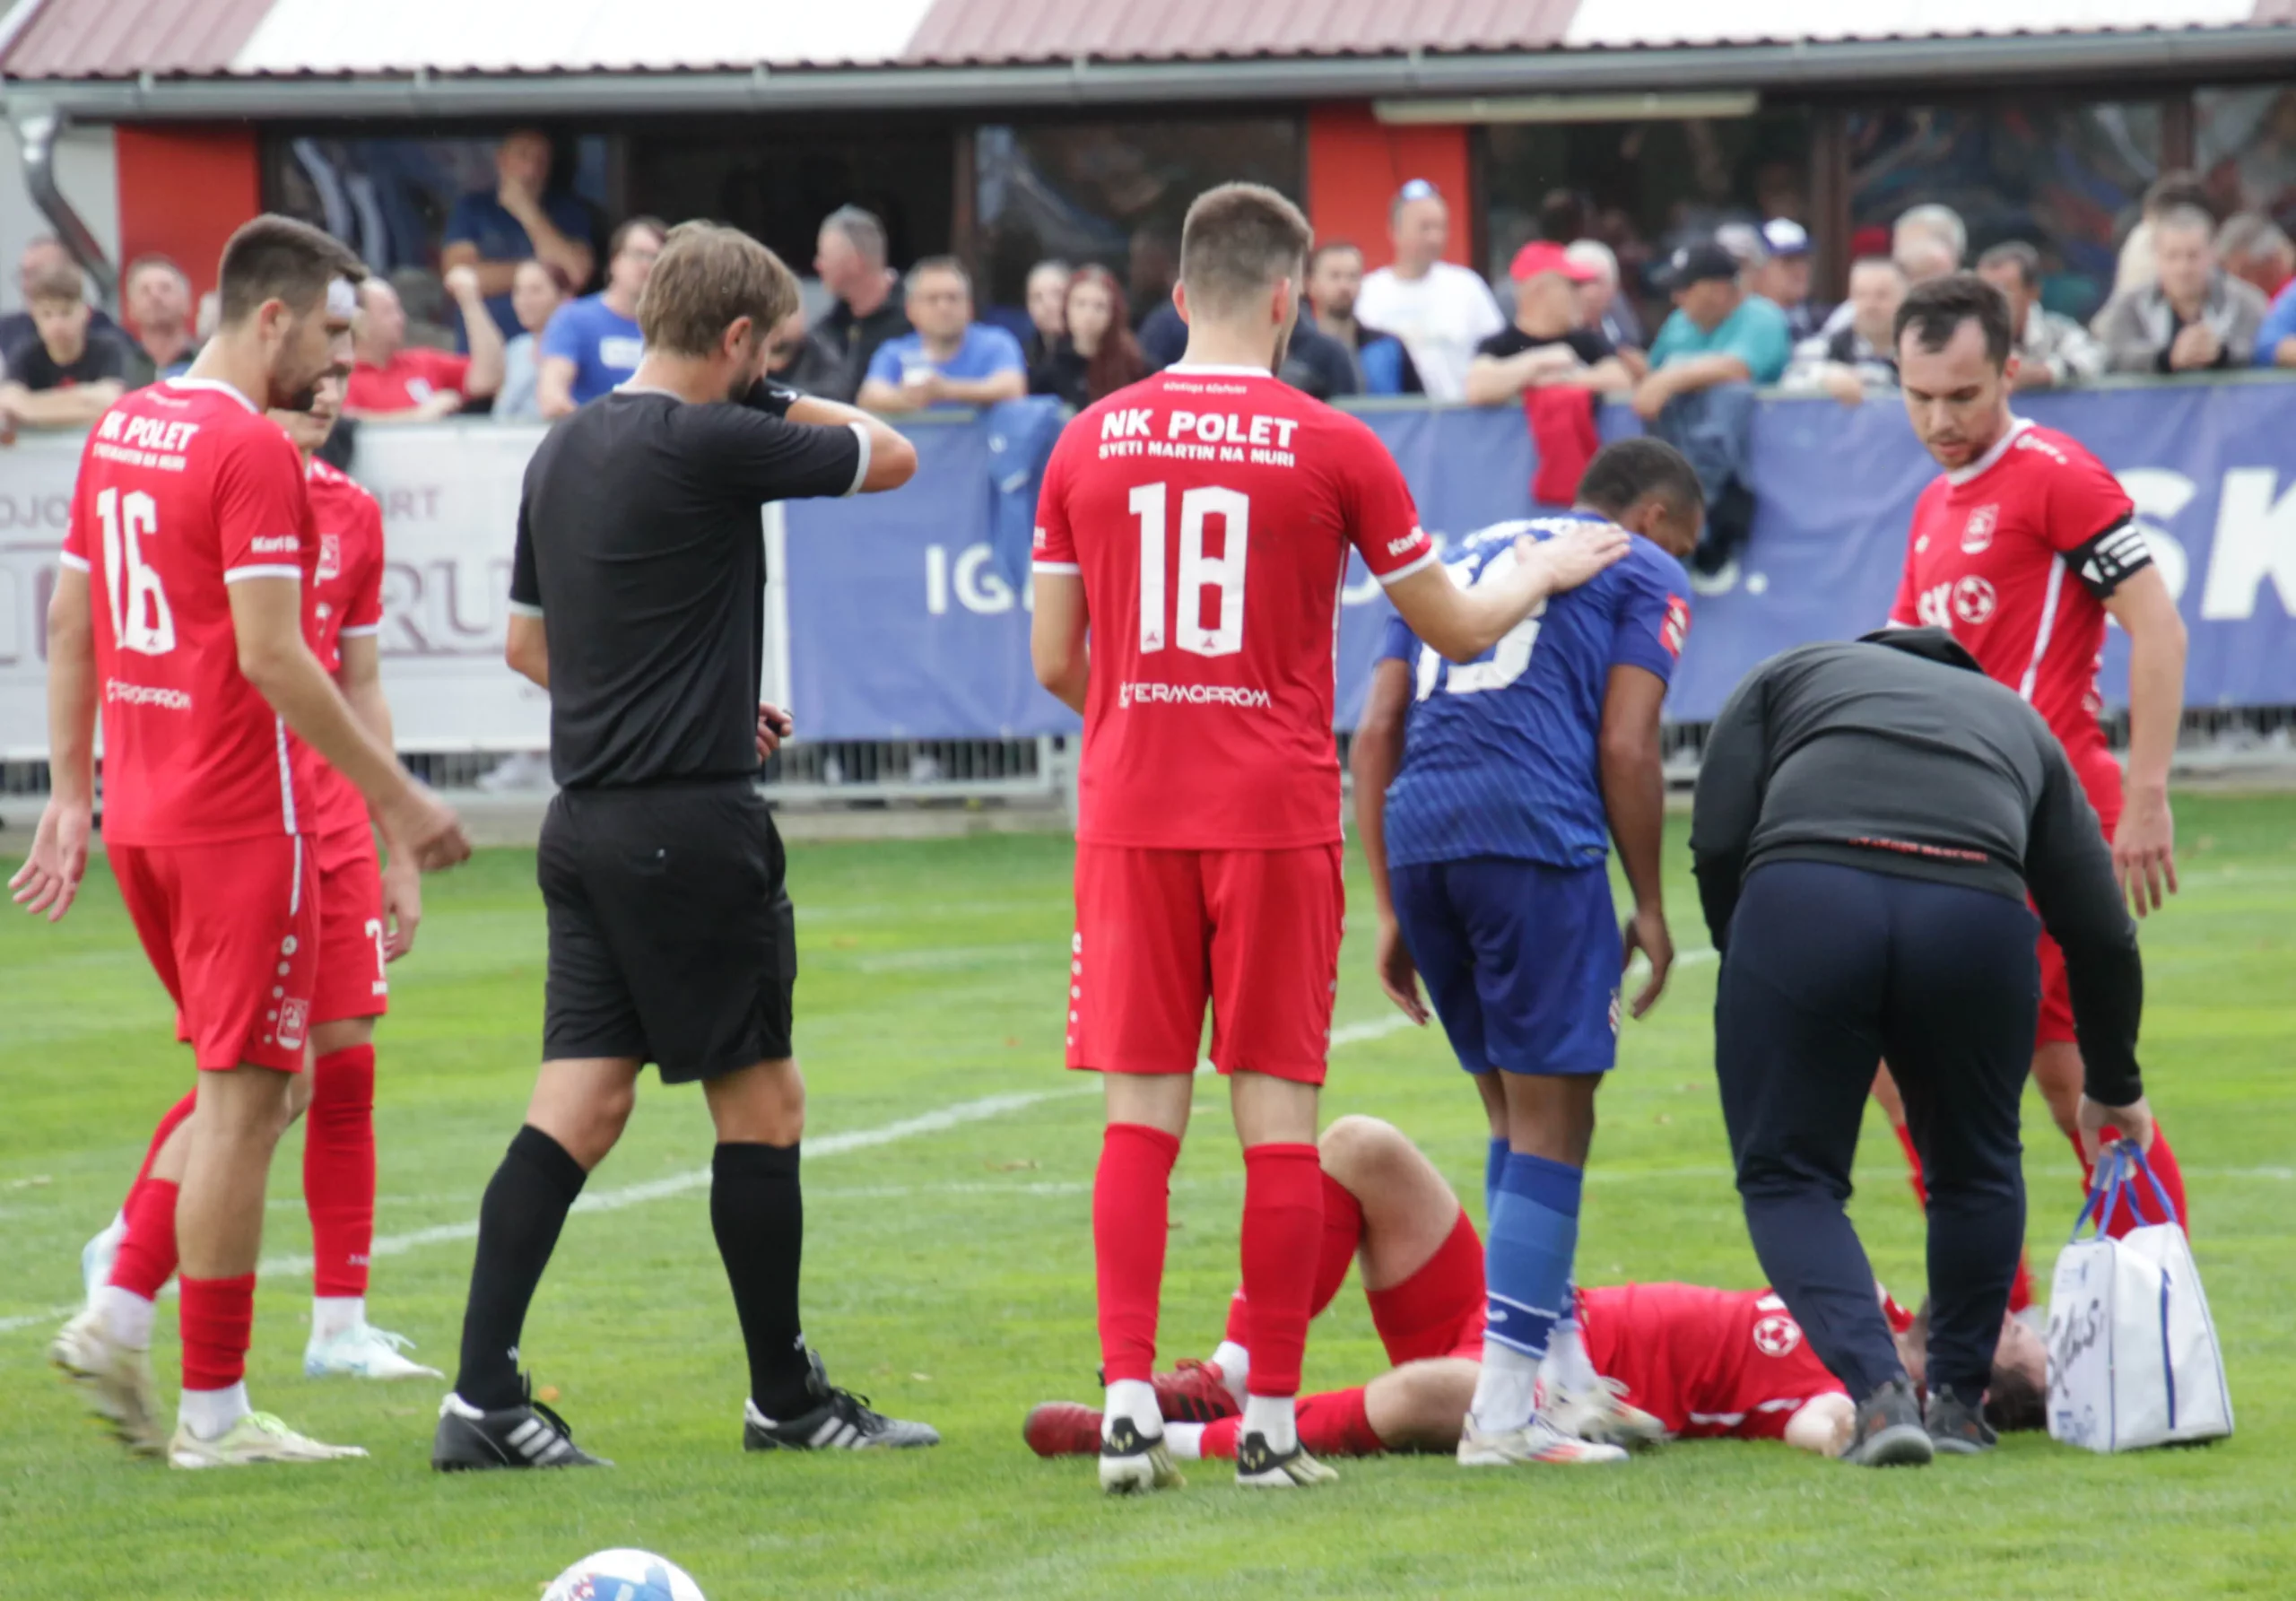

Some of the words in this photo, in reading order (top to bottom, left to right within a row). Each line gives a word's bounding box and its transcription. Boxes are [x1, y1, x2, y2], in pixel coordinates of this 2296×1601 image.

[122, 415, 200, 452] POLET
[1100, 408, 1154, 440] NK
[1168, 410, 1299, 448] POLET
[1098, 439, 1144, 460] SVETI
[1147, 440, 1216, 461] MARTIN
[1219, 446, 1245, 463] NA
[1250, 448, 1296, 468] MURI
[96, 486, 177, 657] 16
[926, 542, 1034, 614] IG
[1128, 481, 1249, 657] 18
[1118, 682, 1273, 709] TERMOPROM
